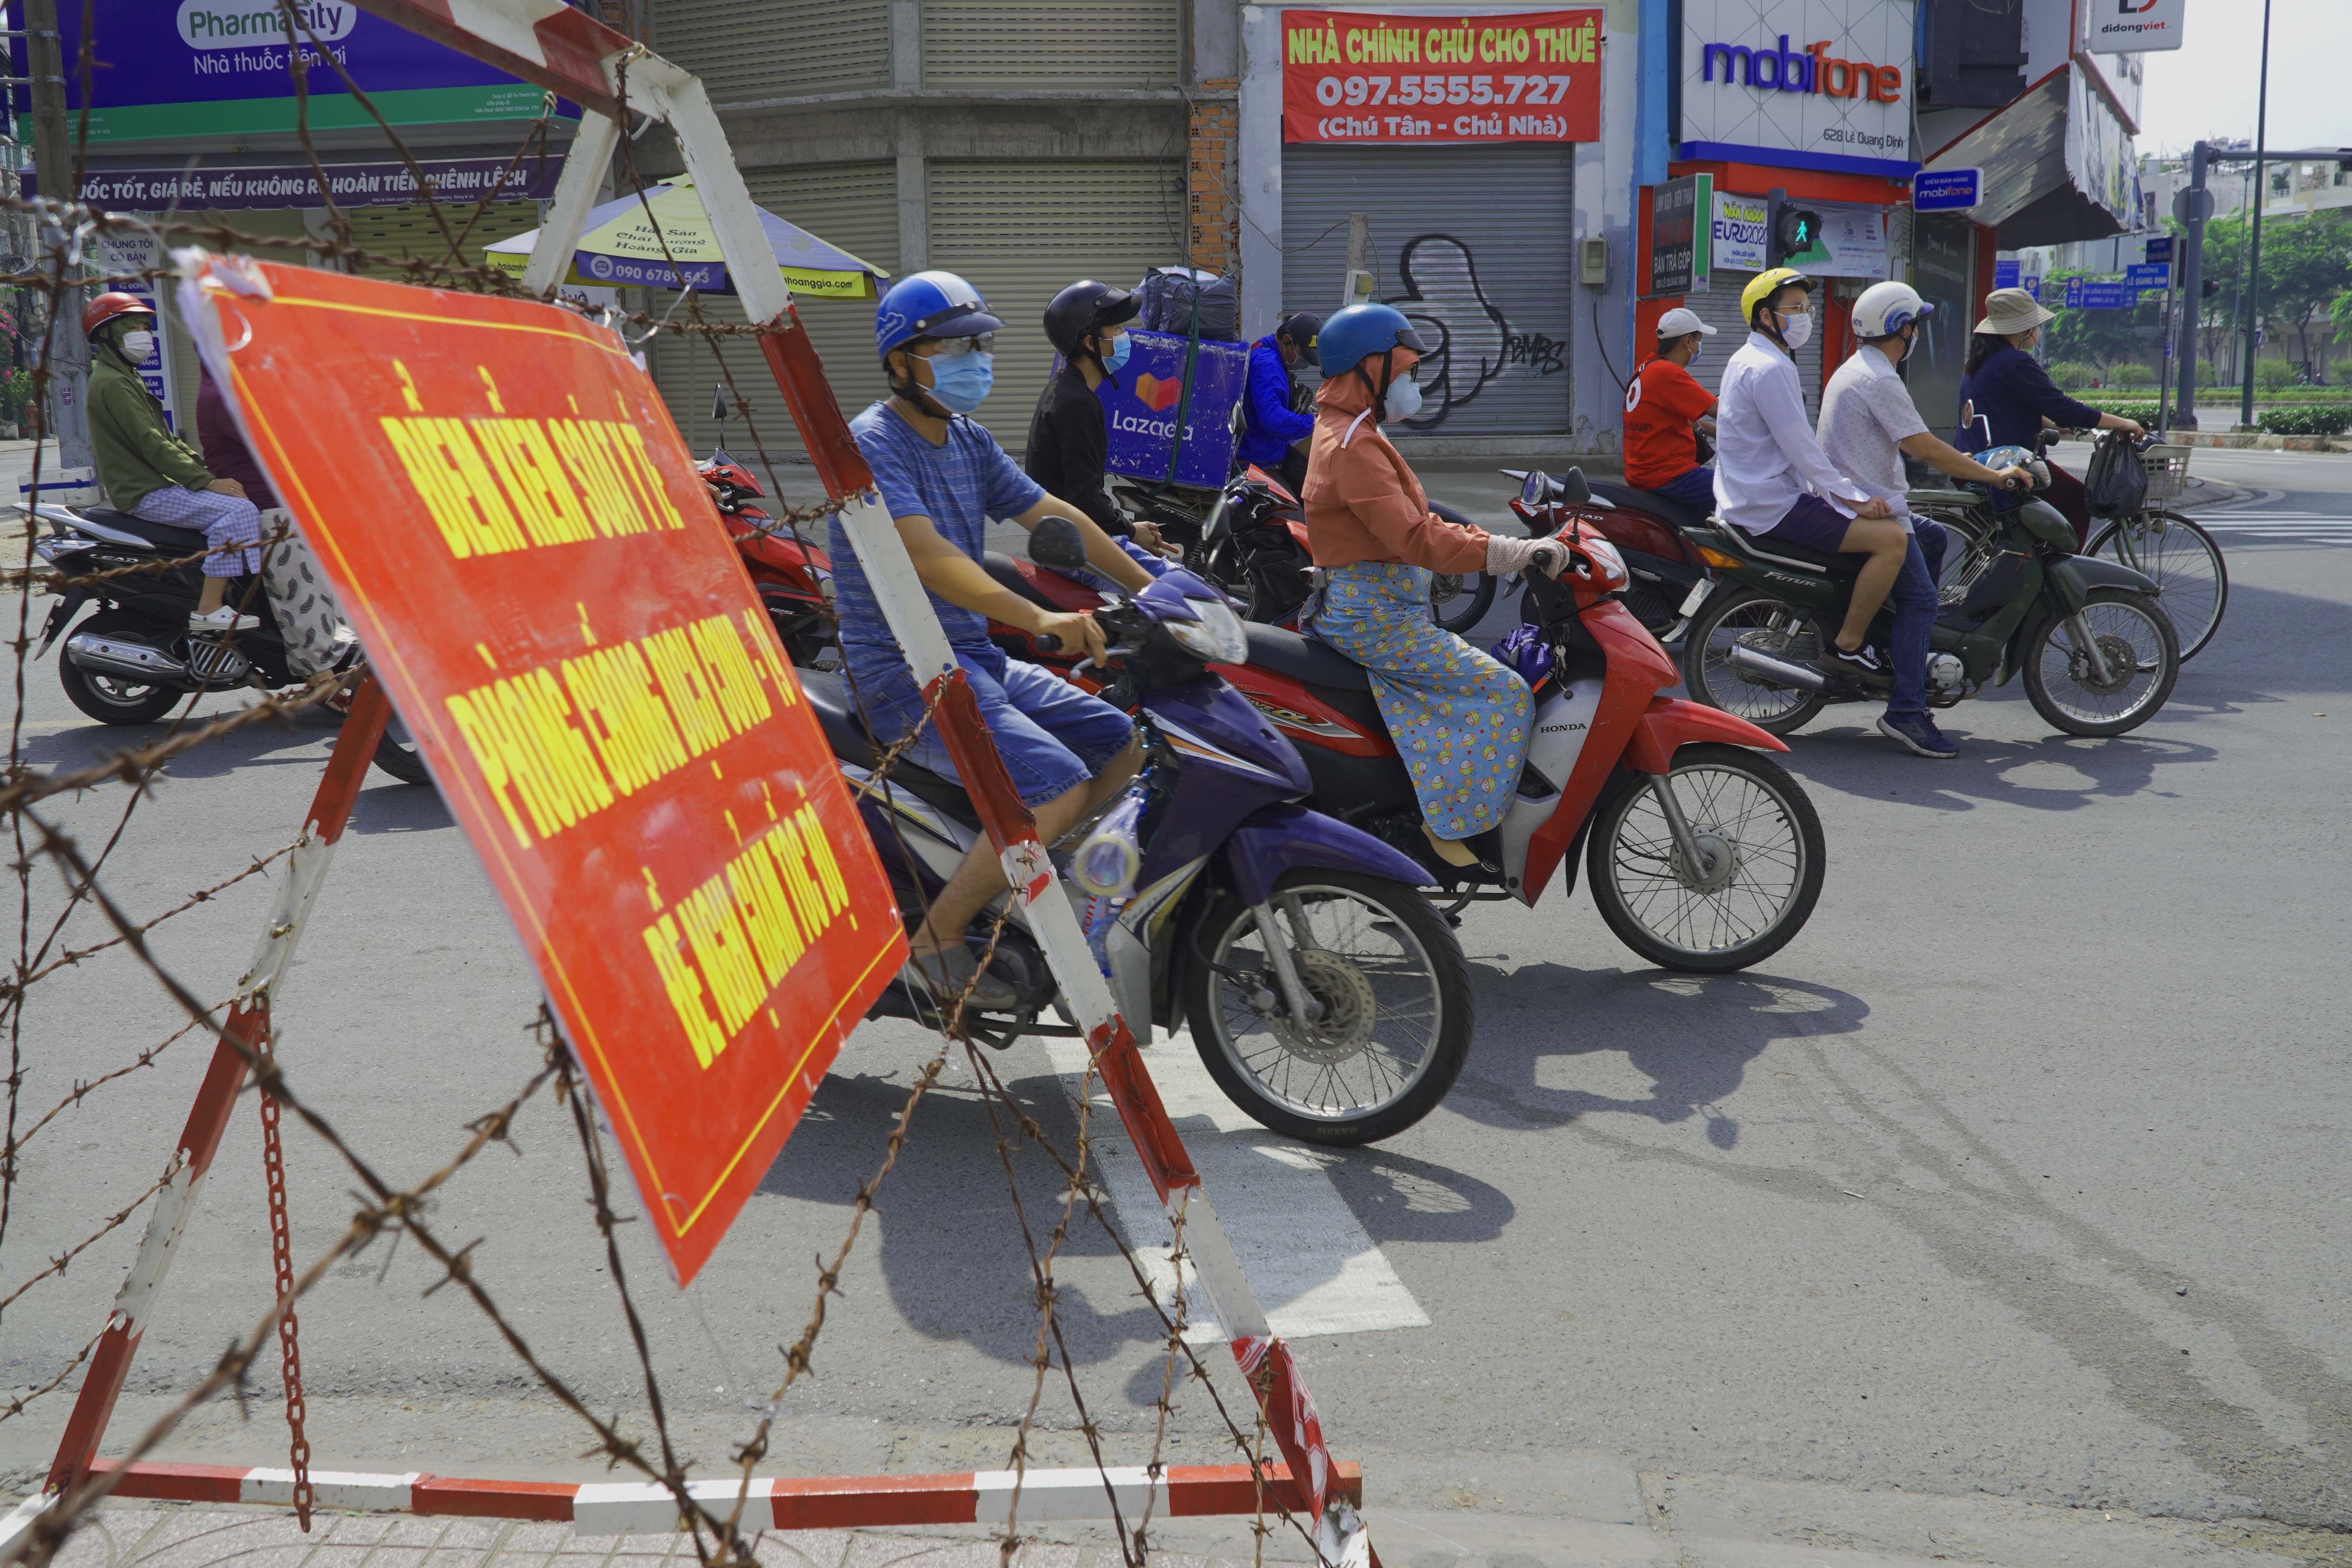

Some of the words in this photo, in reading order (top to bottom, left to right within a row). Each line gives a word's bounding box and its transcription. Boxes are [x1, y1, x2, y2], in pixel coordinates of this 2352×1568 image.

[189, 2, 342, 38] Pharmacity
[1289, 18, 1341, 64] NHÀ
[1346, 21, 1419, 64] CHÍNH
[1425, 18, 1474, 63] CHỦ
[1479, 28, 1529, 63] CHO
[1535, 17, 1595, 63] THUÊ
[194, 54, 229, 75] Nhà
[234, 47, 284, 72] thuốc
[1704, 34, 1902, 103] mobifone
[1316, 75, 1570, 106] 097.5555.727
[1319, 112, 1378, 139] (Chú
[1385, 115, 1431, 137] Tân
[1454, 112, 1503, 137] Chủ
[1509, 114, 1568, 138] Nhà)
[1823, 129, 1843, 142] 628
[1845, 131, 1855, 143] Lê
[1857, 131, 1884, 149] Quang
[1886, 135, 1903, 150] Định
[112, 176, 147, 201] TỐT,
[150, 176, 176, 199] GIÁ
[182, 176, 206, 201] RẺ,
[209, 173, 243, 197] NẾU
[245, 174, 304, 197] KHÔNG
[332, 171, 380, 194] HOÀN
[384, 168, 419, 192] TIỀN
[431, 167, 480, 190] CHÊNH
[1919, 186, 1973, 198] mobifone
[101, 238, 136, 248] CHÚNG
[138, 238, 153, 248] TÔI
[127, 251, 146, 261] BÁN
[615, 242, 665, 254] Hoàng
[672, 246, 698, 254] Gia
[663, 237, 706, 246] ượng
[616, 265, 642, 279] 090
[646, 269, 679, 282] 6789
[1654, 252, 1665, 274] BÁN
[1666, 249, 1677, 272] TRẢ
[1678, 247, 1691, 271] GÓP
[2136, 276, 2153, 286] QUANG
[379, 359, 529, 559] ĐIỂM
[470, 365, 596, 547] KIỂM
[547, 394, 648, 538] SOÁT
[617, 389, 685, 529] TẾ
[605, 421, 663, 530] Y
[89, 554, 139, 562] LEAD
[444, 643, 614, 849] PHÒNG
[561, 601, 689, 796] CHỐNG
[640, 627, 732, 780] DỊCH
[689, 614, 772, 735] COVID
[744, 607, 797, 707] 19
[1540, 723, 1587, 733] HONDA
[762, 781, 830, 945] TỐC
[793, 779, 858, 932] ĐỘ
[723, 809, 805, 988] GIẢM
[641, 866, 727, 1071] ĐỀ
[675, 874, 780, 1030] NGHỊ
